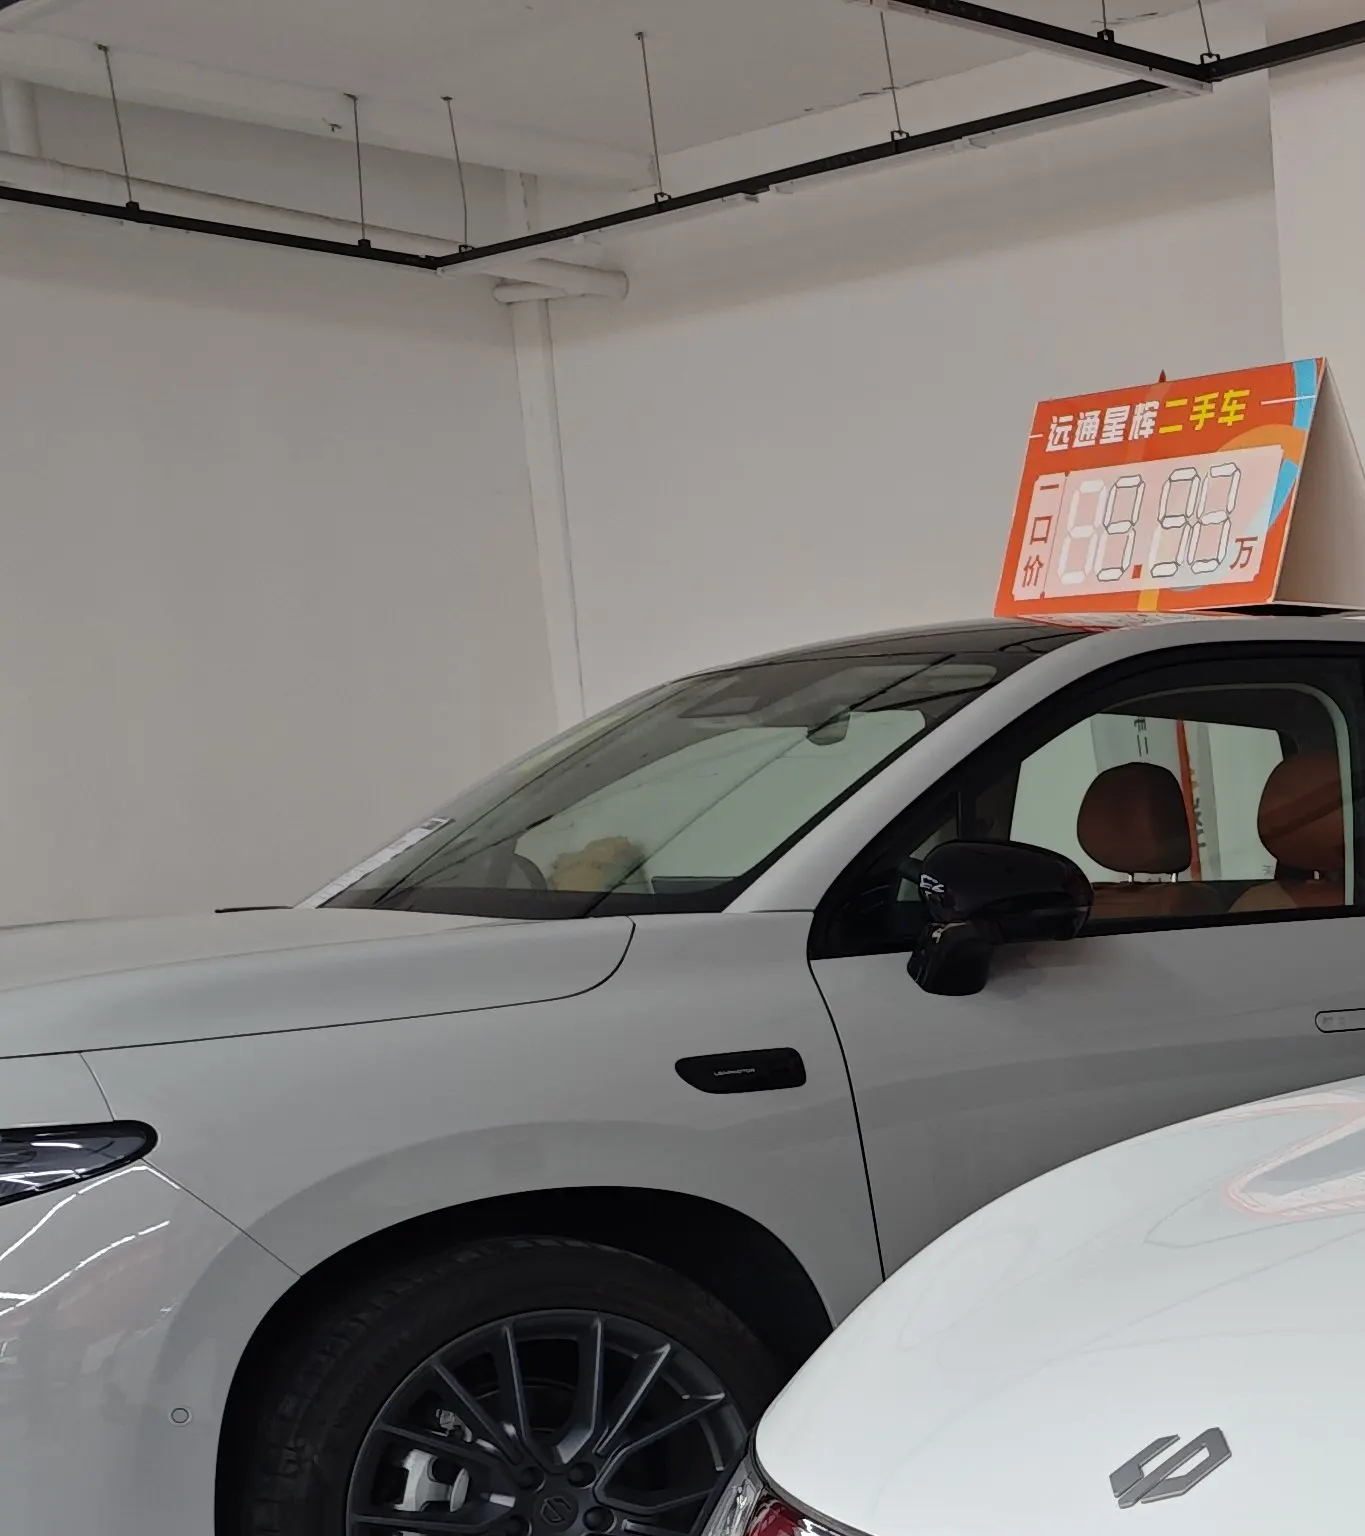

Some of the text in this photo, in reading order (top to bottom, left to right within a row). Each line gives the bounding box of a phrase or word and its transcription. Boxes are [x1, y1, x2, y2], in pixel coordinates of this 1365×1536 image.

[1045, 389, 1251, 453] 远通星辉二手车
[1022, 482, 1061, 588] 一口价
